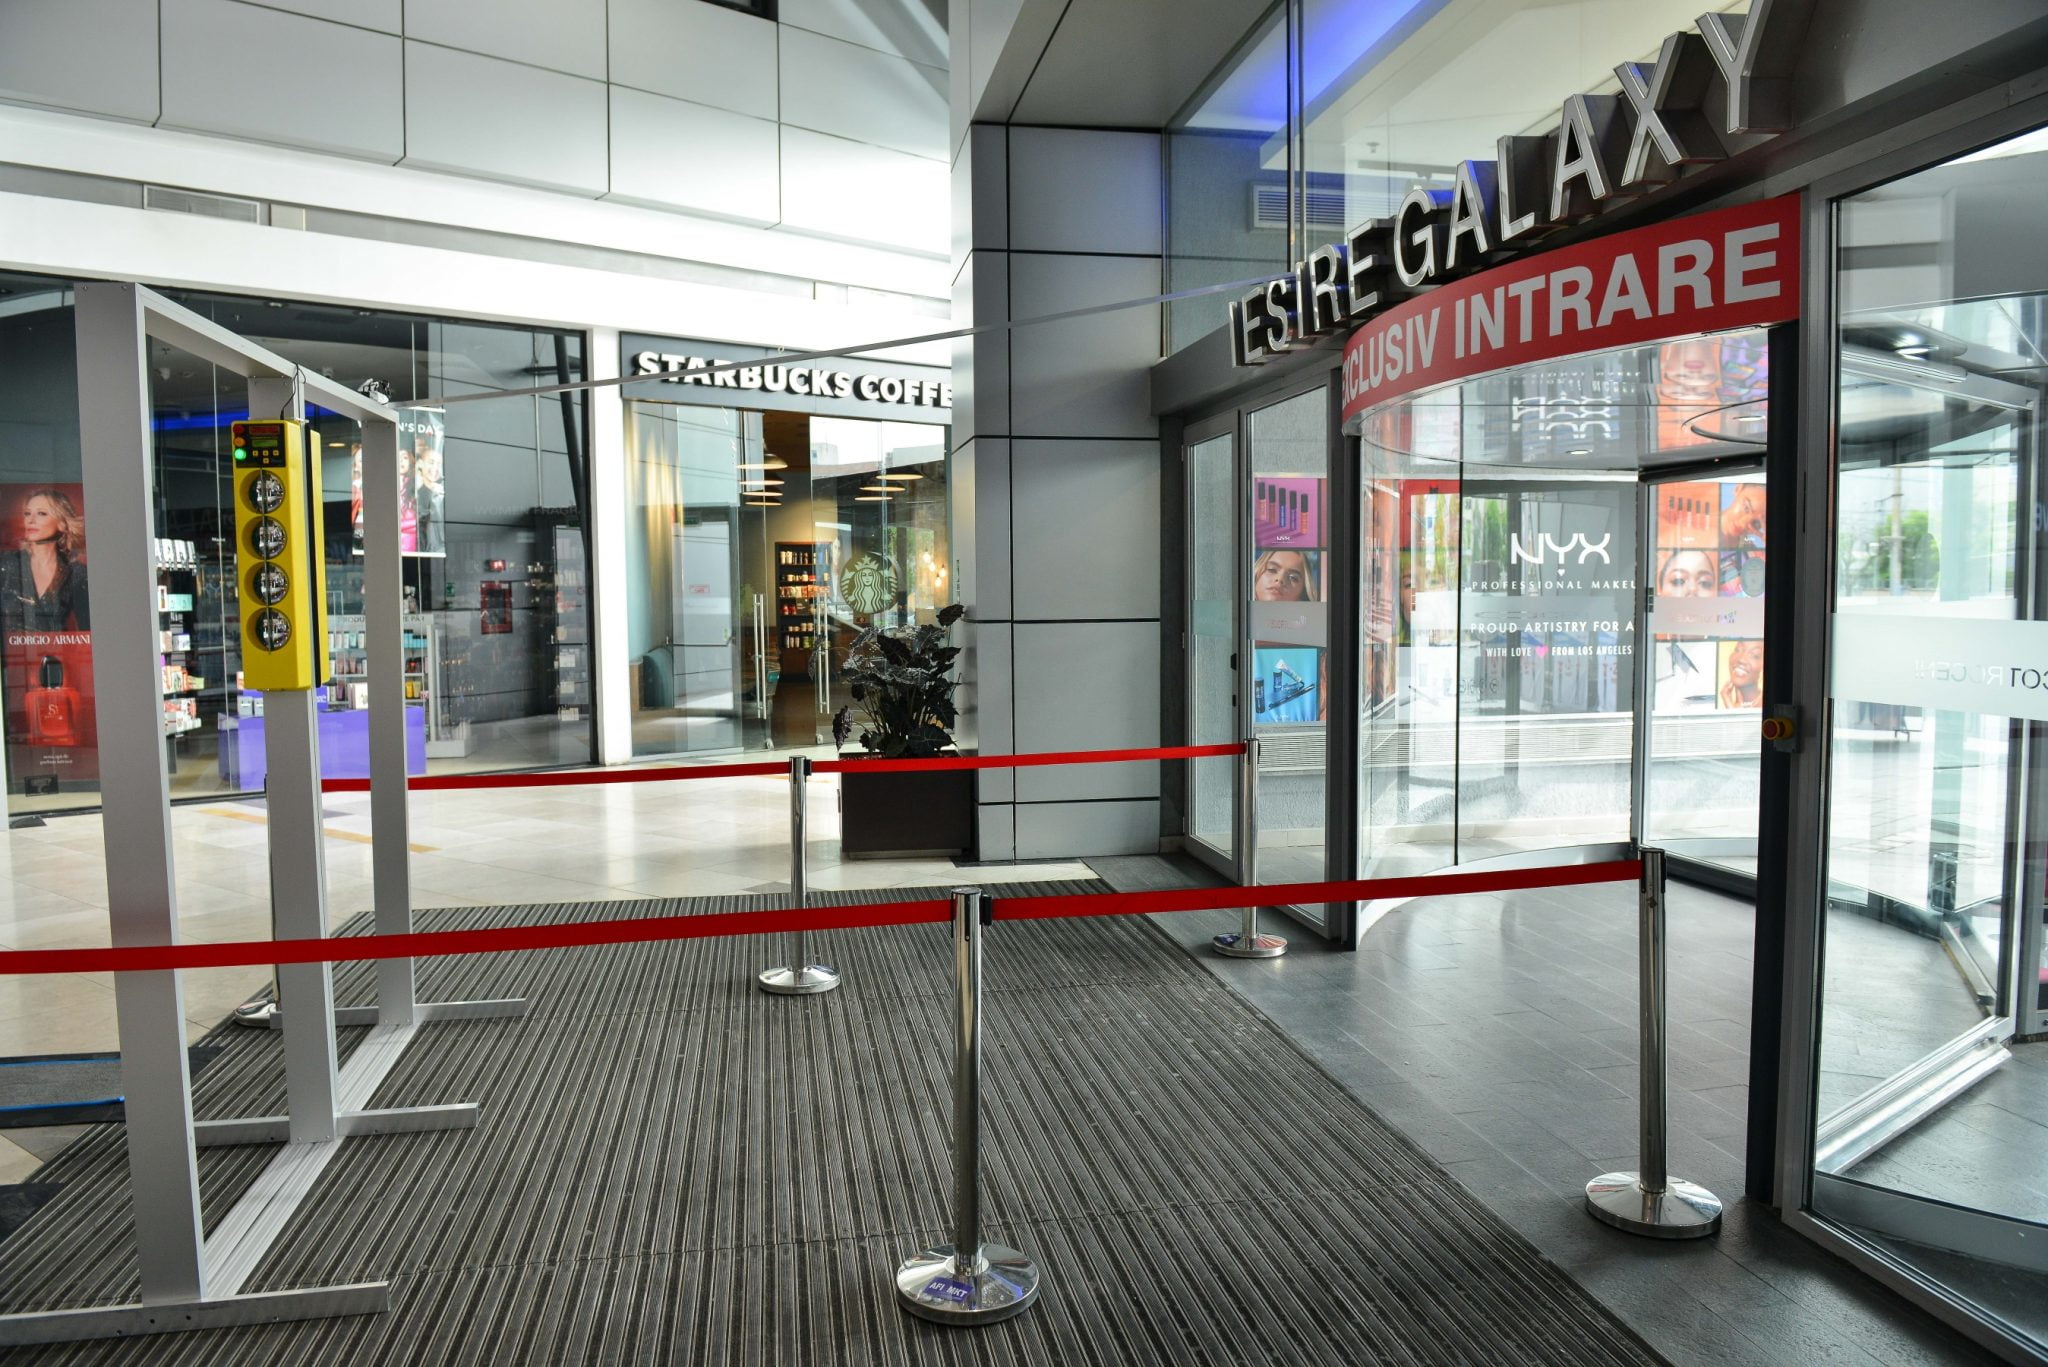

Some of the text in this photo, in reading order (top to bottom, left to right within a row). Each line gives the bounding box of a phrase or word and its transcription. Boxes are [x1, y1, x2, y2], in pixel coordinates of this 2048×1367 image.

[1228, 0, 1768, 369] IESIRE GALAXY
[1454, 222, 1781, 358] INTRARE
[634, 351, 853, 398] STARBUCKS
[1511, 533, 1610, 564] NYX
[1472, 581, 1583, 590] PROFESSIONAL
[1470, 622, 1518, 634] PROUD
[1524, 621, 1588, 633] ARTISTRY
[1593, 621, 1620, 632] FOR
[8, 634, 91, 646] GIORGIO ARMANI
[1486, 645, 1633, 657] WITH LOVE FROM LOS ANGELES
[929, 1281, 967, 1298] AFI MKT
